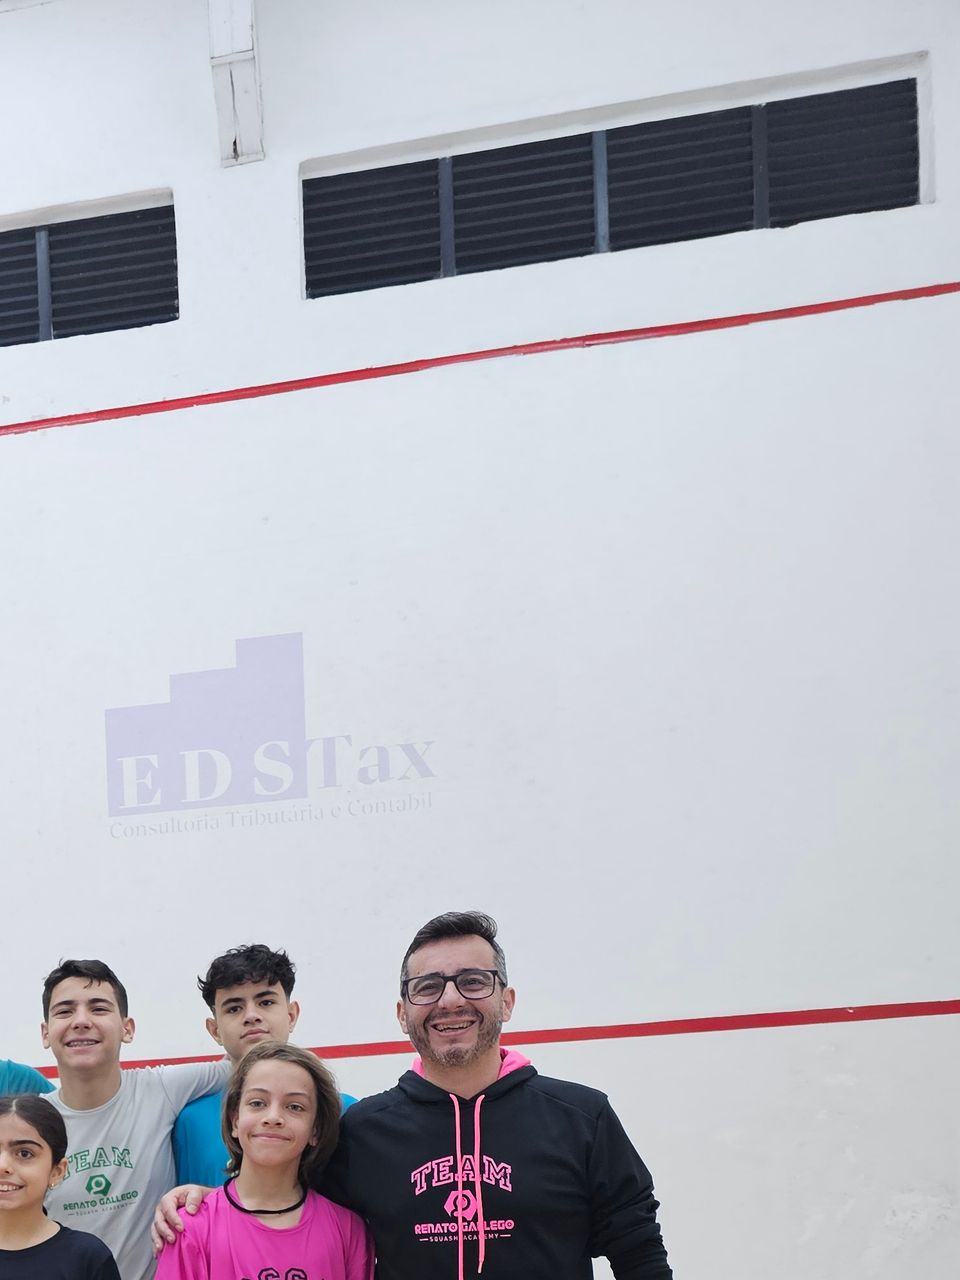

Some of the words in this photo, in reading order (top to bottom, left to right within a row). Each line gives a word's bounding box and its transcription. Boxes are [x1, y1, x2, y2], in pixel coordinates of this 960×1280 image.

[109, 813, 221, 840] Consultoria
[330, 805, 342, 818] e
[411, 1154, 513, 1196] TEAM
[63, 1199, 98, 1211] RENATO
[99, 1190, 139, 1206] GALLEGO
[414, 1222, 458, 1235] RENATO
[428, 1235, 458, 1243] SQUASH
[463, 1233, 499, 1241] ACAEMY
